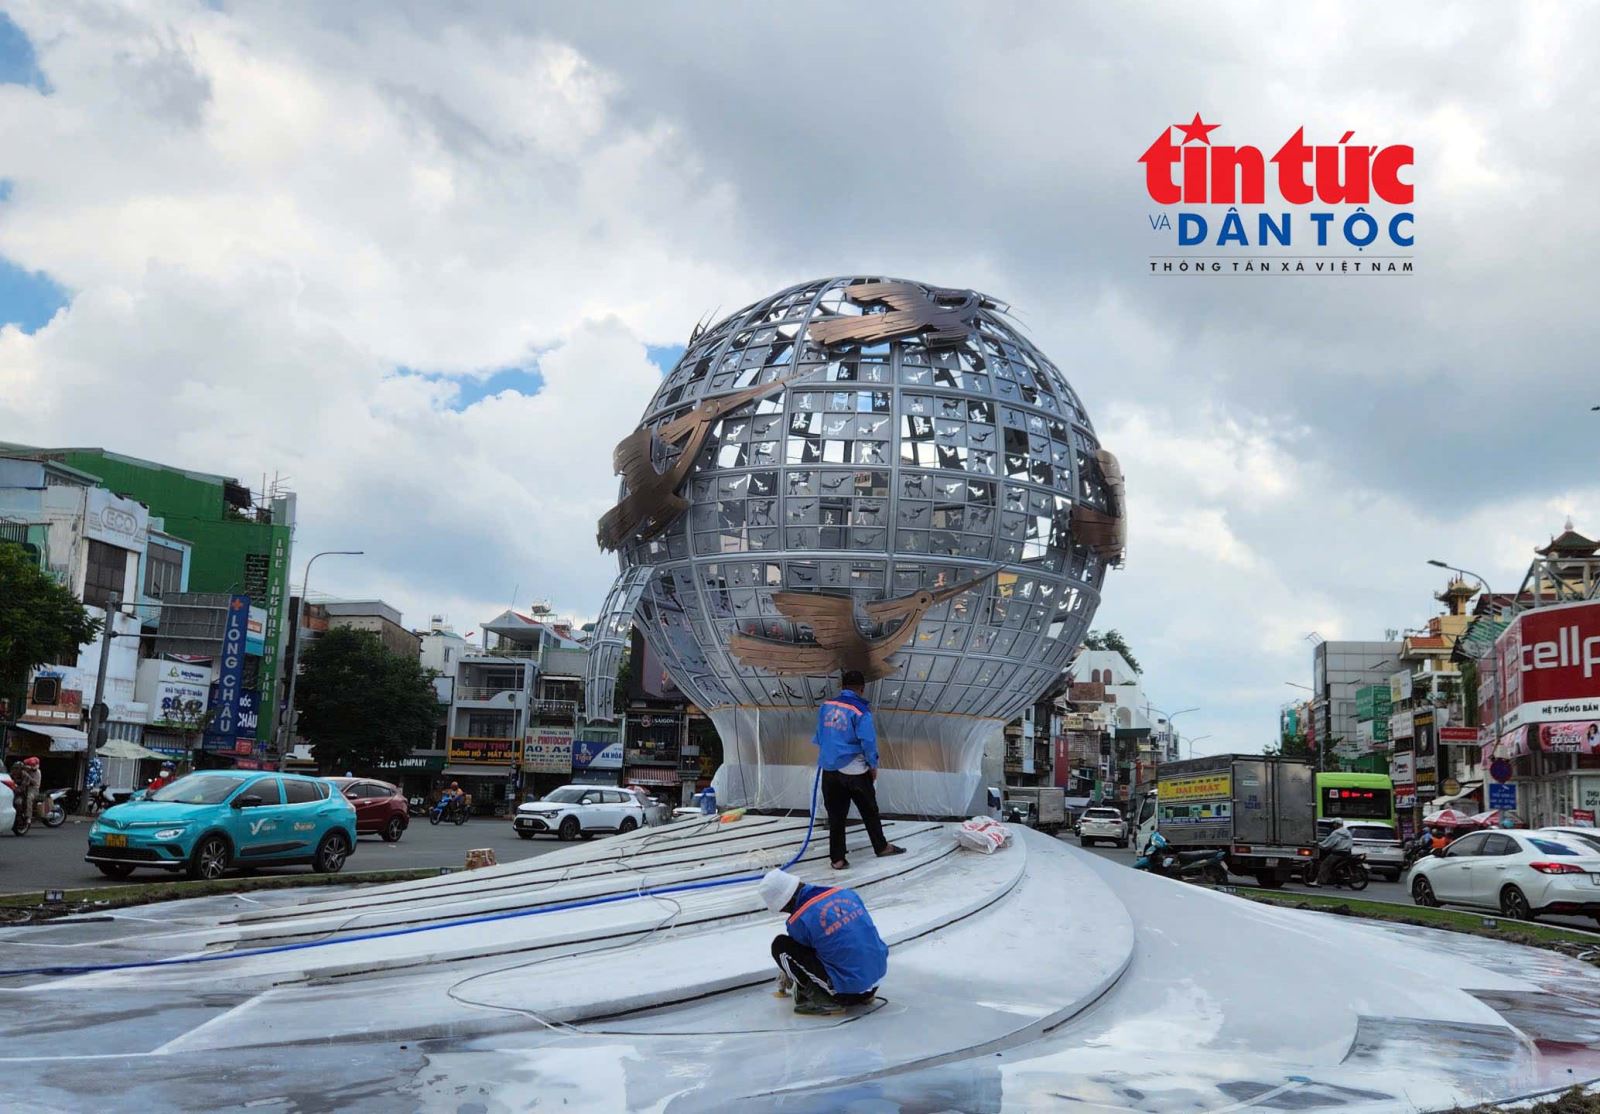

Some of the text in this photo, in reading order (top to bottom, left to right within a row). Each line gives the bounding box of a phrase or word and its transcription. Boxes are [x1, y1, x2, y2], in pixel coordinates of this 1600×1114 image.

[224, 614, 241, 669] LONG
[220, 674, 236, 732] CHÂU
[1542, 705, 1552, 715] HỆ
[1554, 703, 1581, 713] THỐNG
[538, 736, 572, 745] PHOTOCOPY
